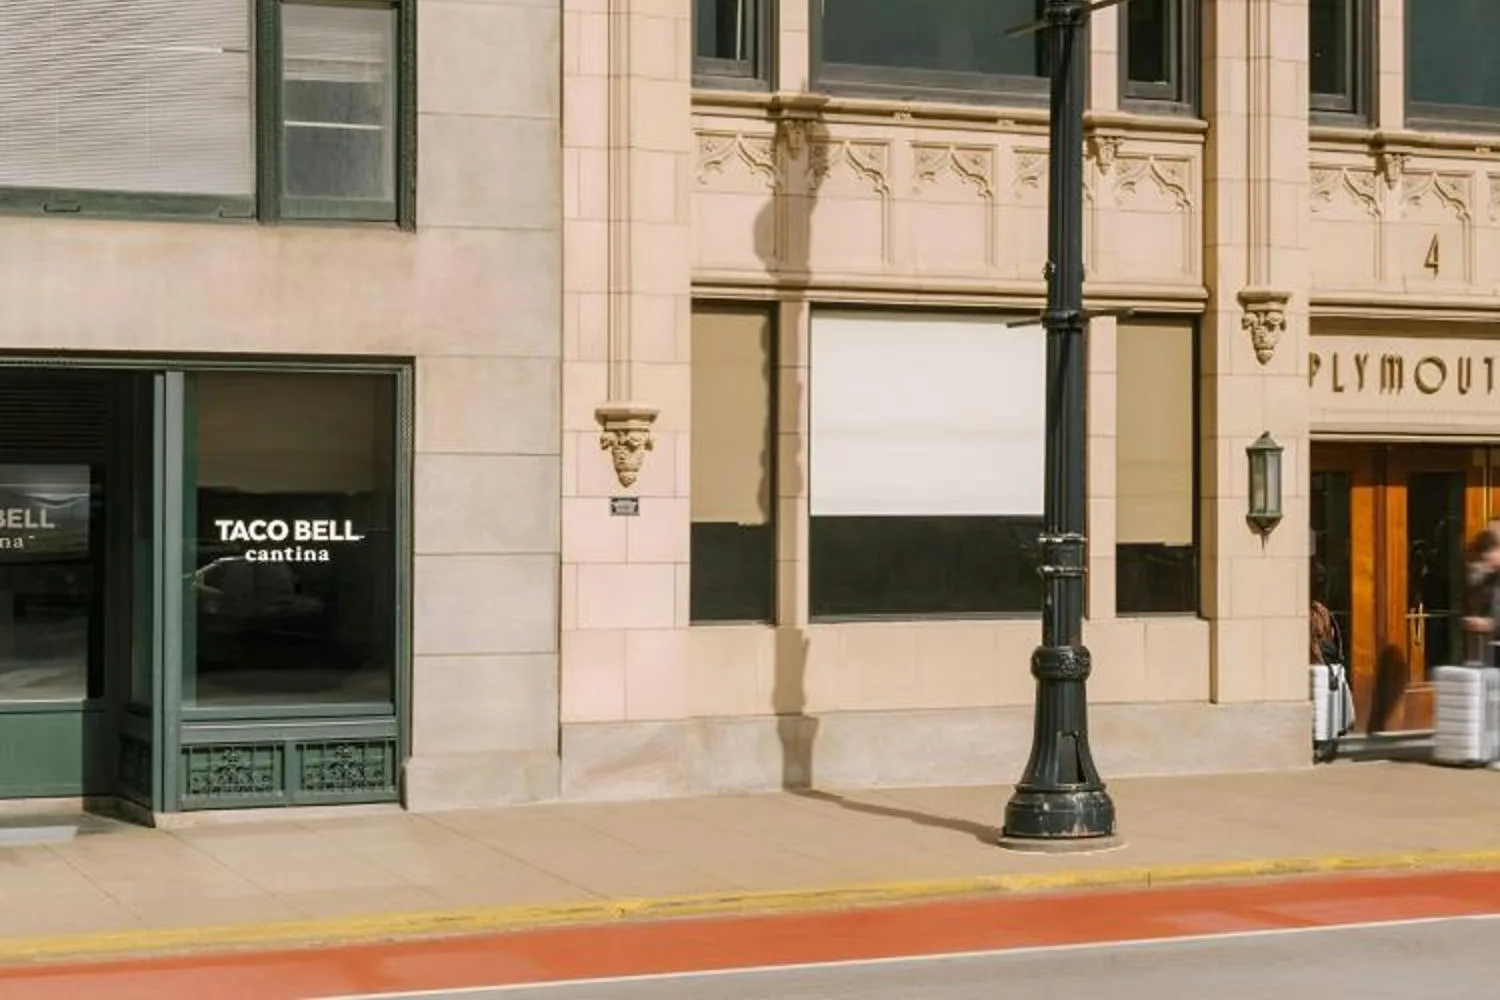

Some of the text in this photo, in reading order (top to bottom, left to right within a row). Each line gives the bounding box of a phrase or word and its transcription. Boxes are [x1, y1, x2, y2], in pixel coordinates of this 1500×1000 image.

[215, 519, 361, 541] TACO BELL
[245, 546, 330, 561] cantina
